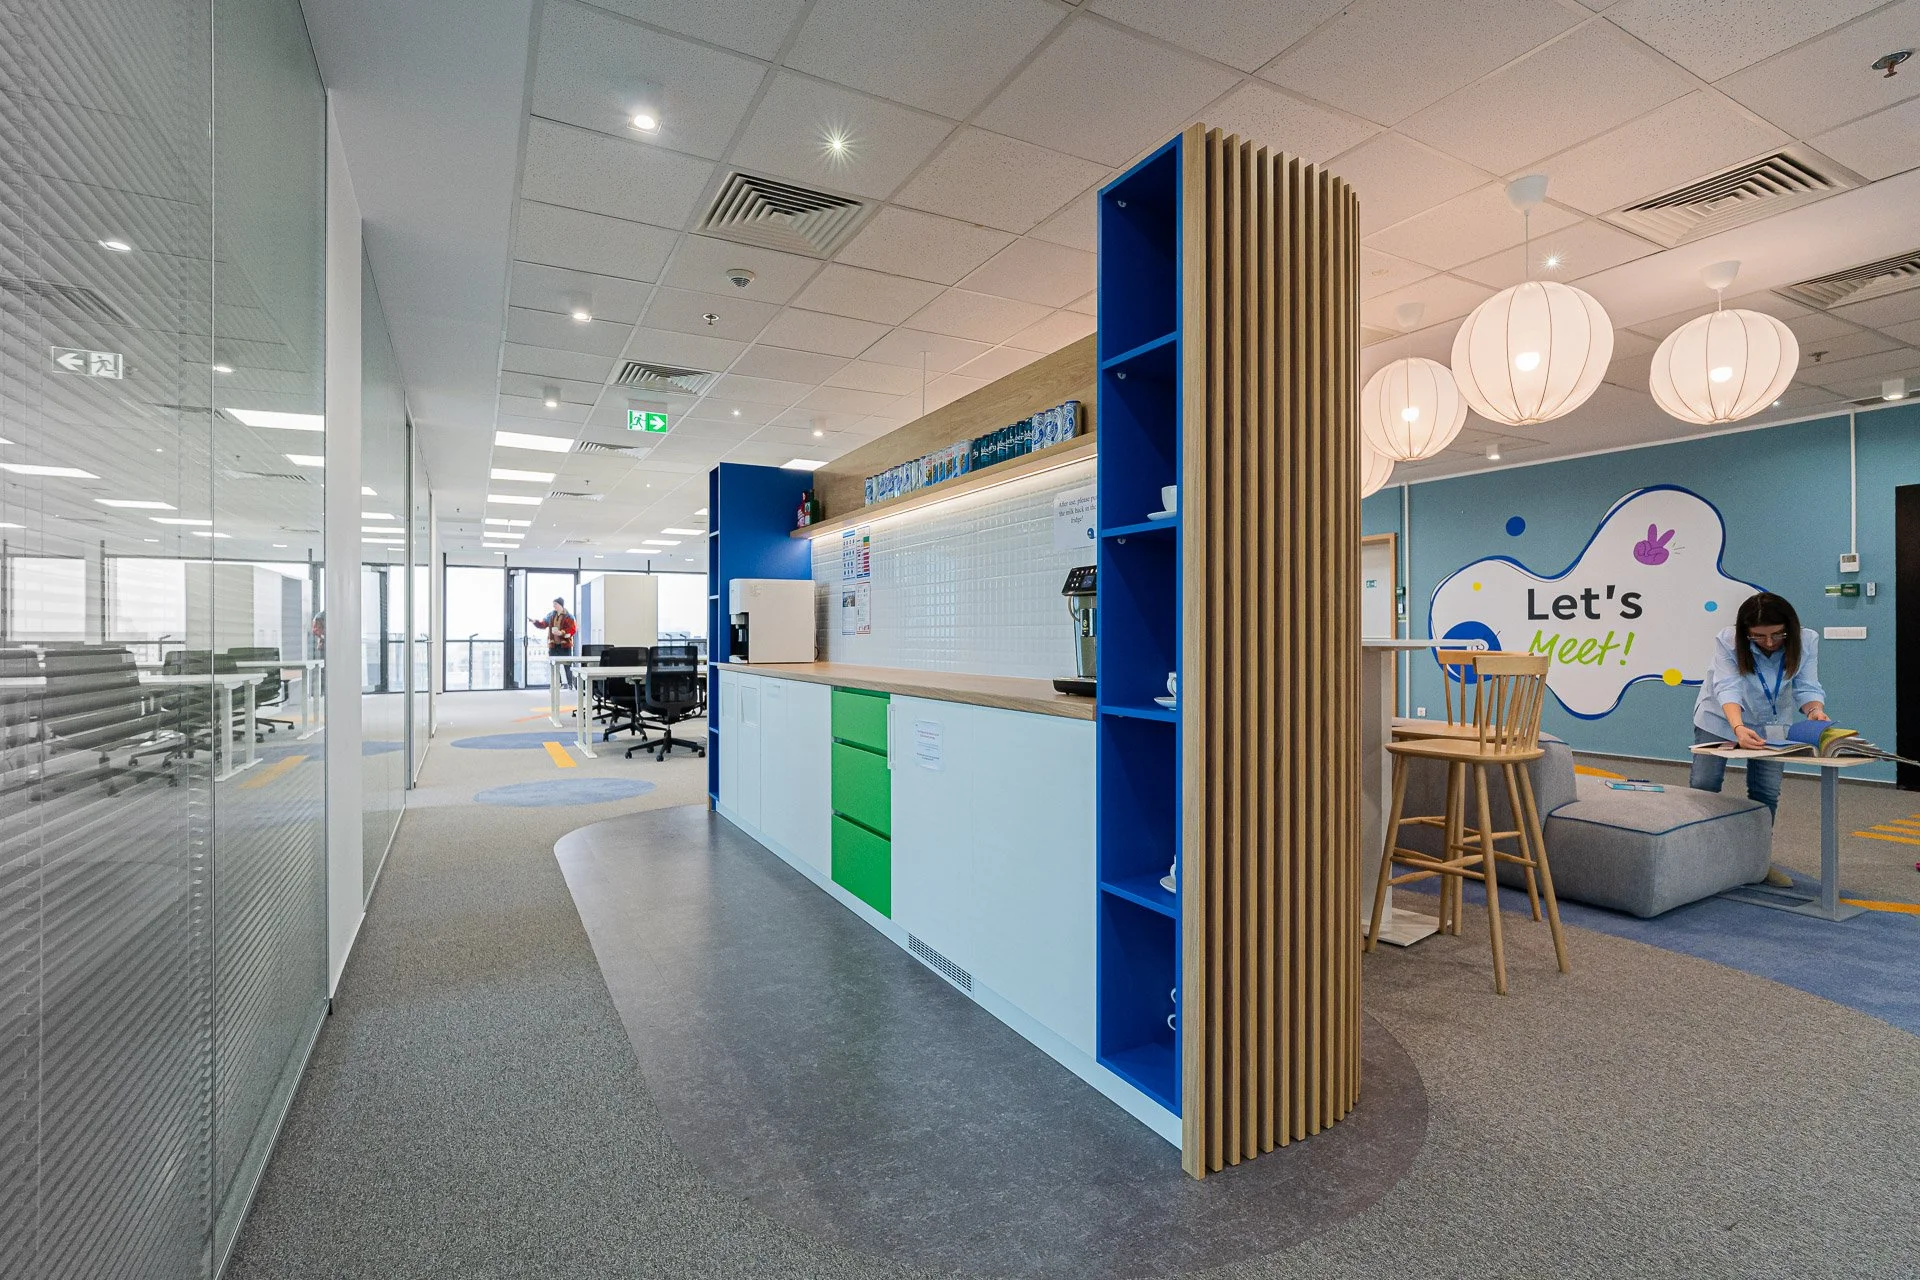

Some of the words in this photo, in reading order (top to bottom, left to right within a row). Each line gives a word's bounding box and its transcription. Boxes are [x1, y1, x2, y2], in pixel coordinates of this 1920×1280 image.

[1077, 497, 1090, 506] please
[1527, 584, 1643, 621] Let's
[1528, 629, 1635, 667] Meet!
